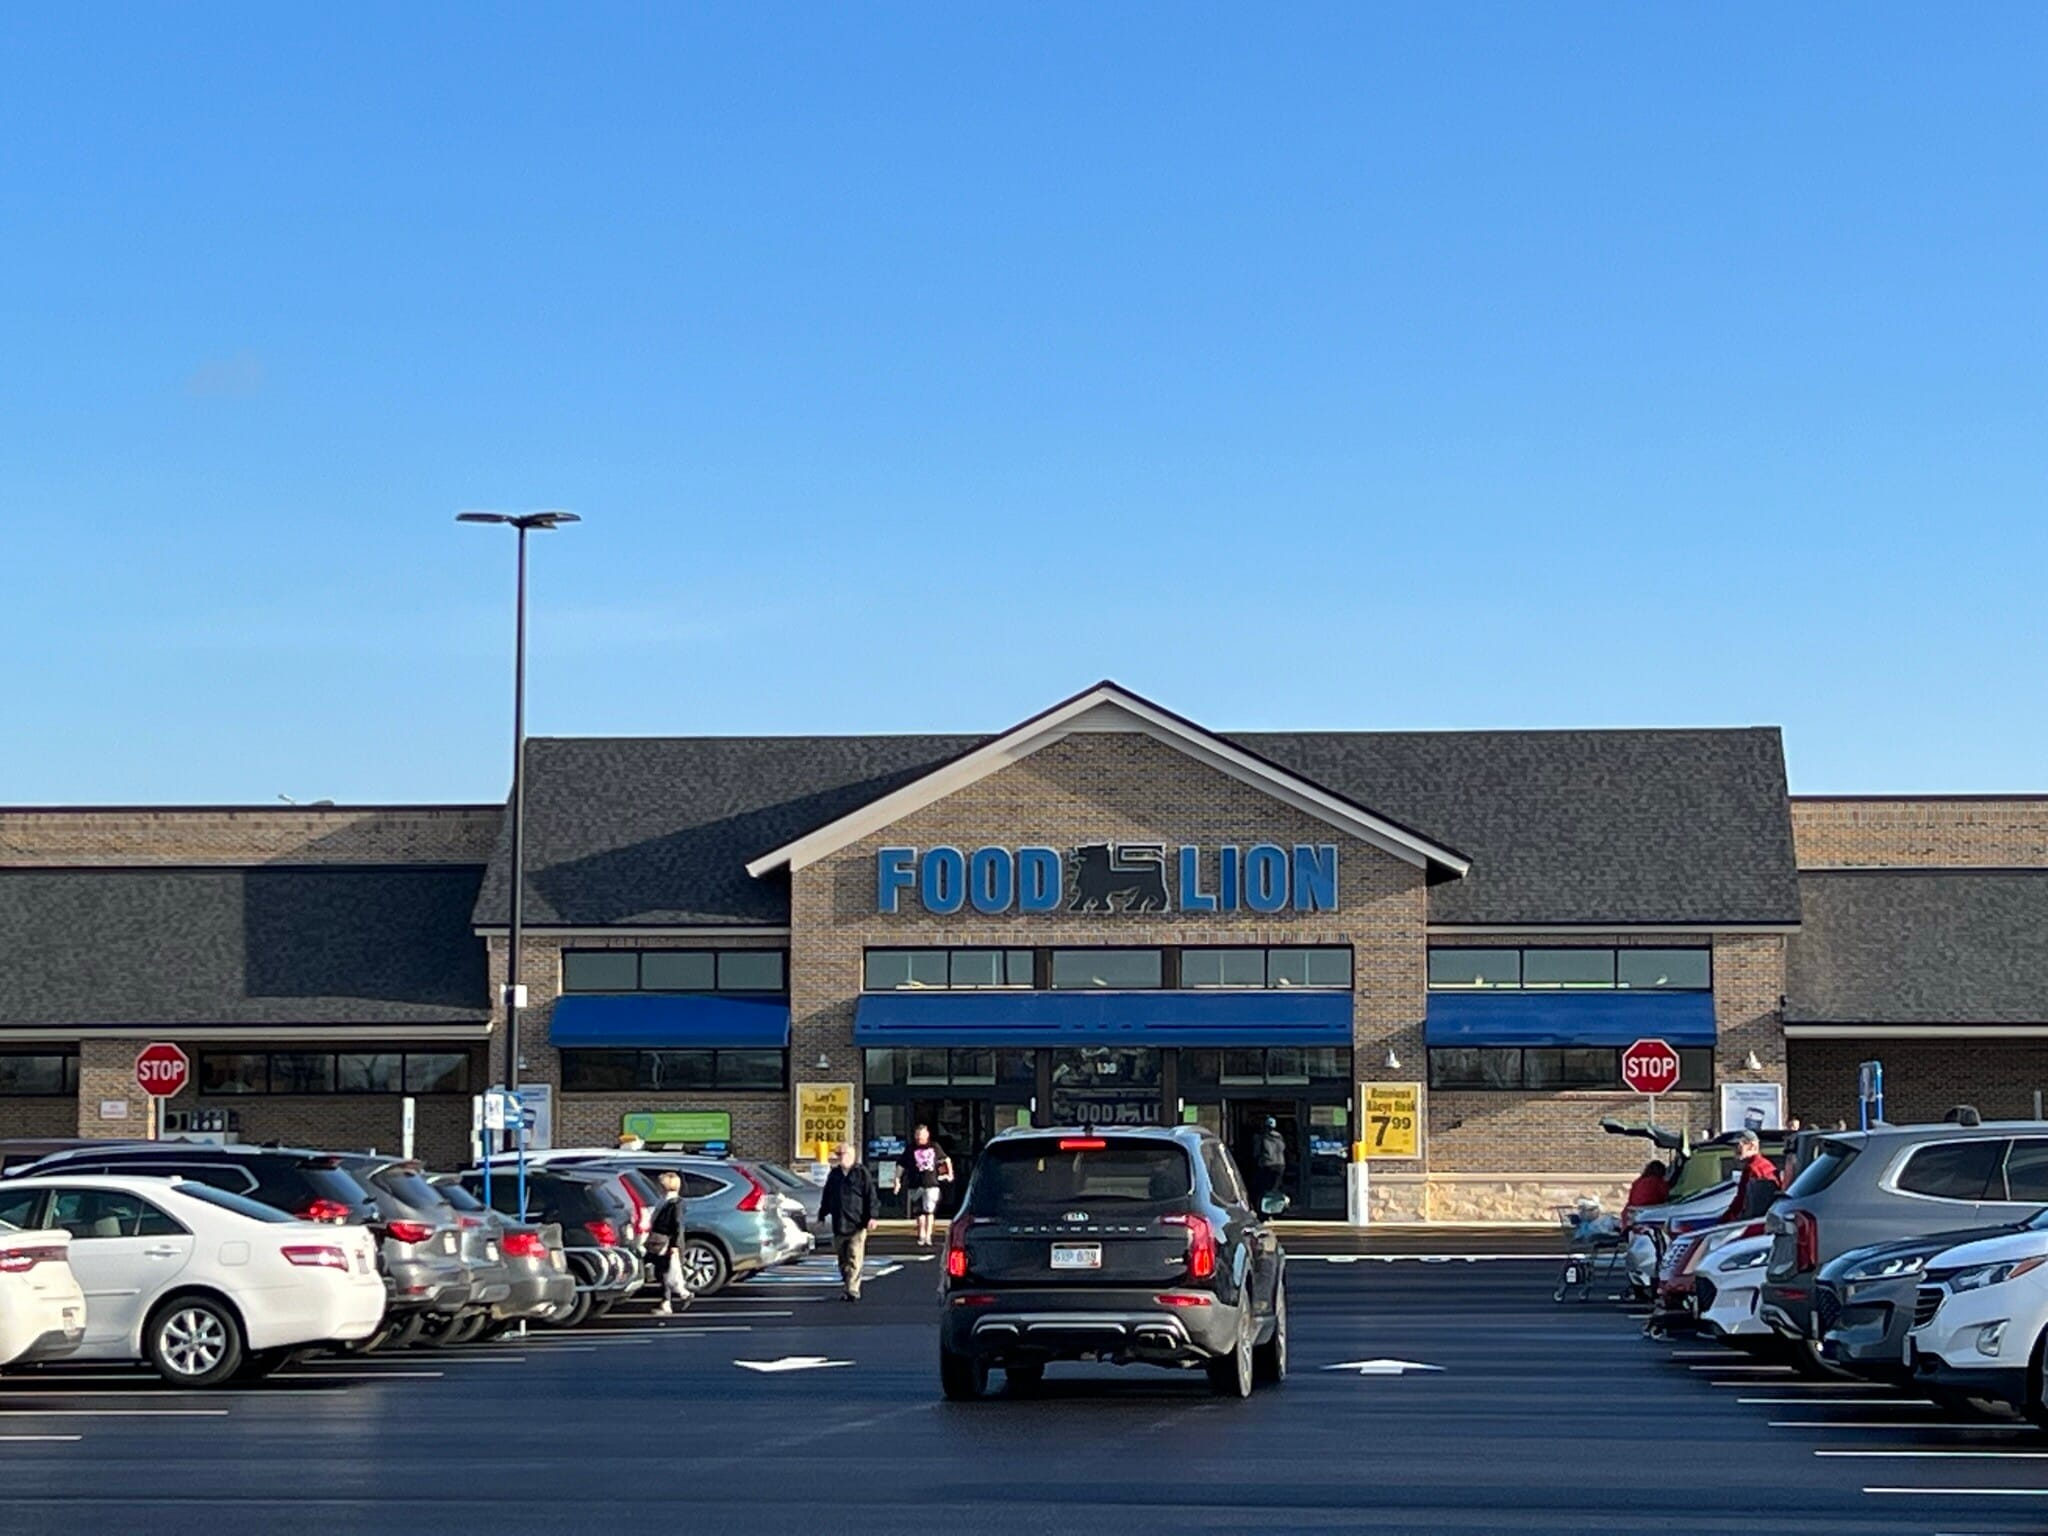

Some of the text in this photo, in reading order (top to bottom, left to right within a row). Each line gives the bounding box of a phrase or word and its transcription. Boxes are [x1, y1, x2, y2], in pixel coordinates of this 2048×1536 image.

[877, 843, 1339, 915] FOOD LION
[139, 1060, 184, 1081] STOP
[1627, 1056, 1675, 1078] STOP
[1077, 1103, 1113, 1122] OOD
[805, 1119, 846, 1130] BOGO
[805, 1131, 845, 1142] FREE
